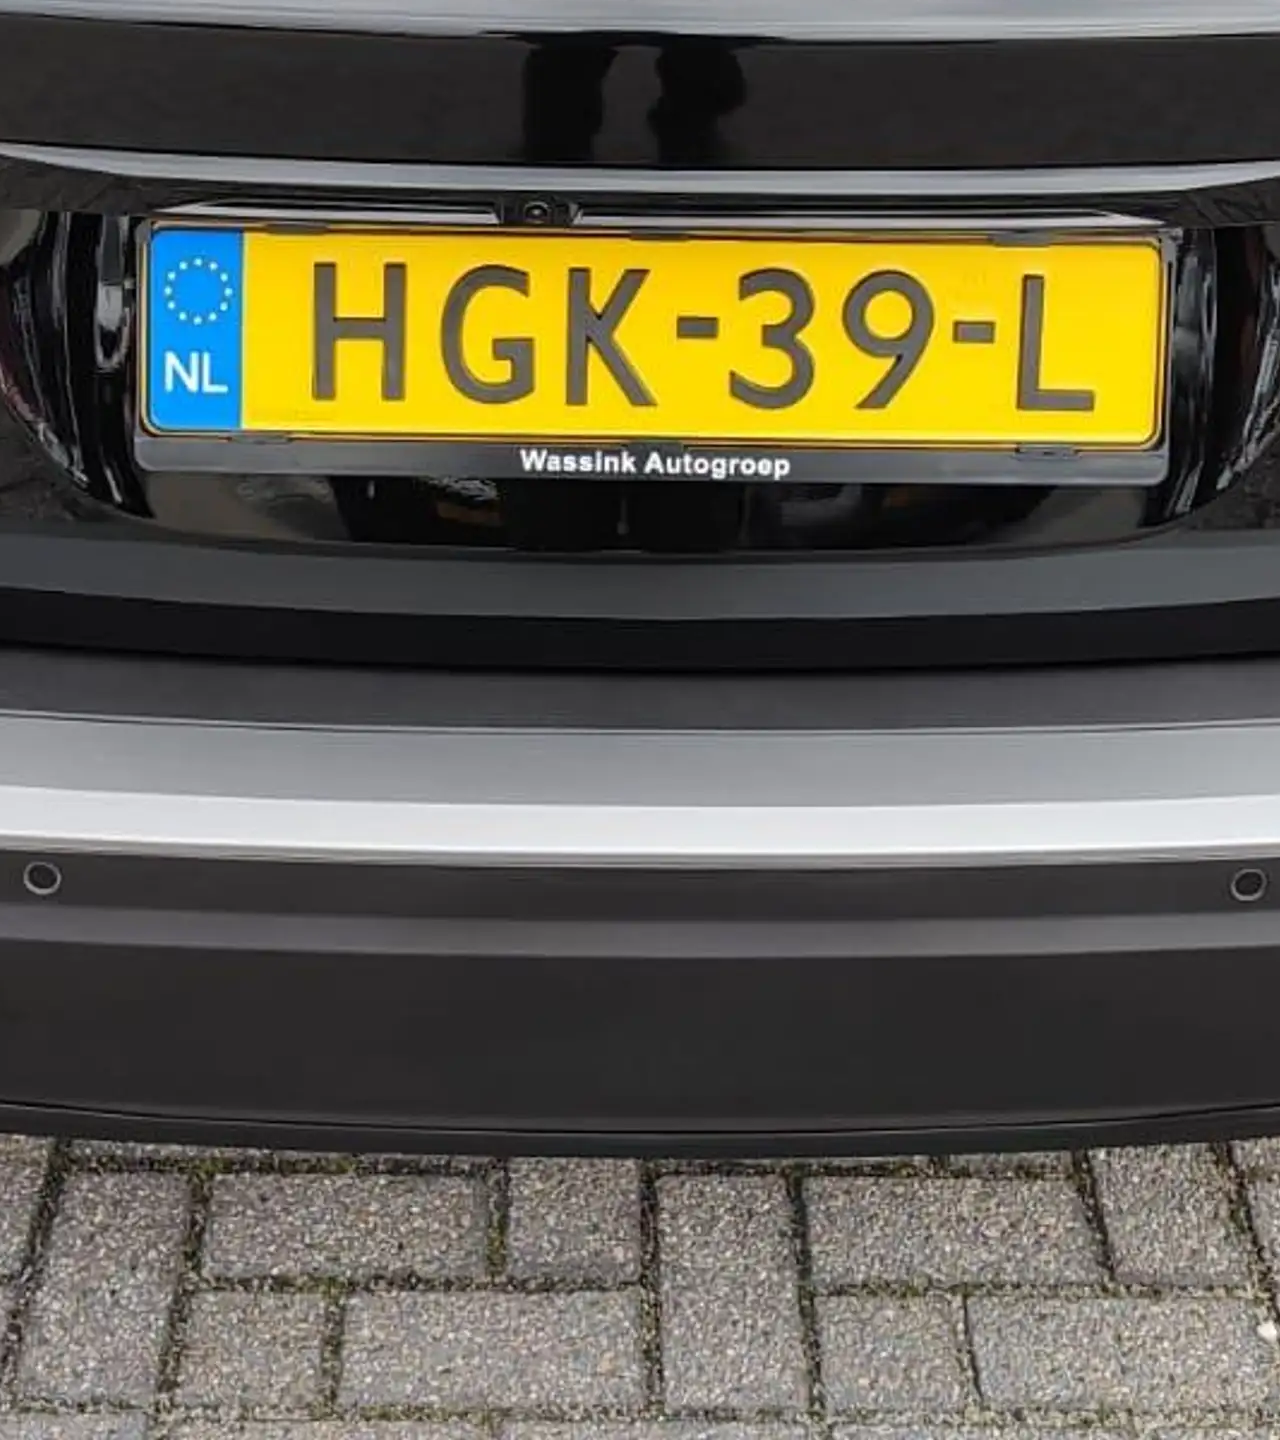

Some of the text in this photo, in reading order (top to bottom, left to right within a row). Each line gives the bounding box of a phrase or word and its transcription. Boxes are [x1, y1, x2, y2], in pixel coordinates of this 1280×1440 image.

[311, 262, 1096, 411] HGK-39-L
[163, 350, 229, 394] NL
[519, 448, 791, 480] Wassink Autogroep
